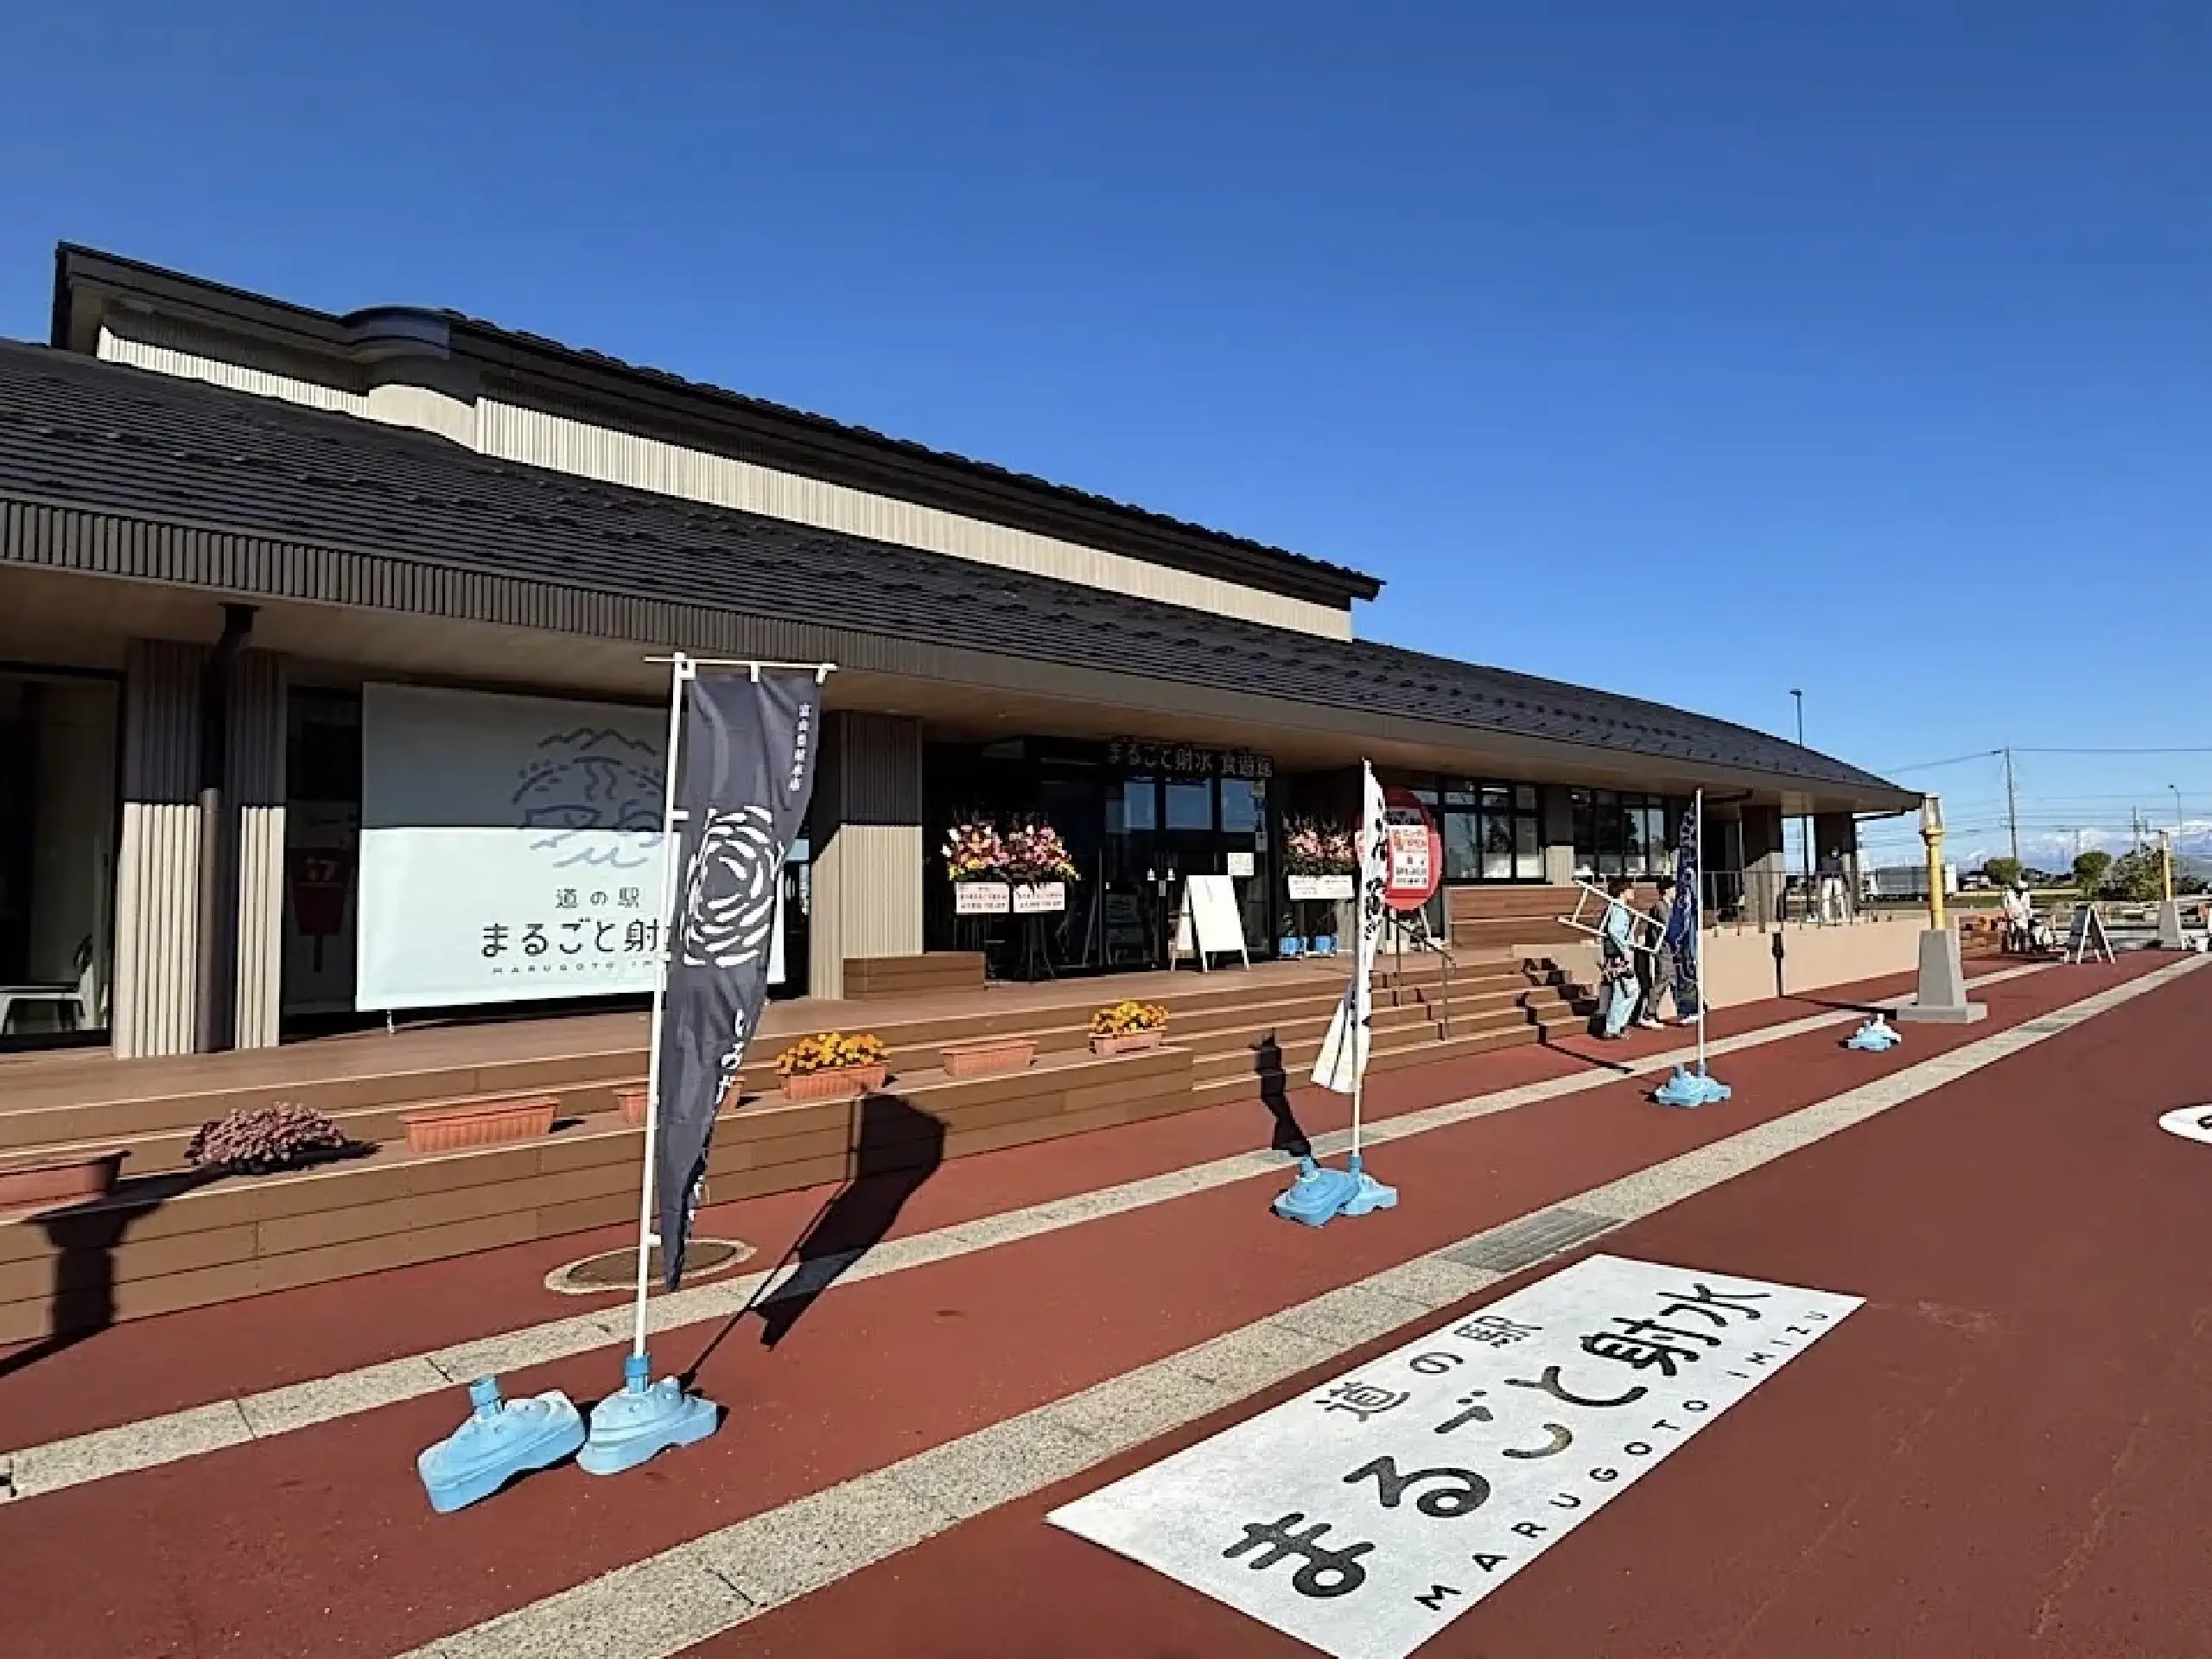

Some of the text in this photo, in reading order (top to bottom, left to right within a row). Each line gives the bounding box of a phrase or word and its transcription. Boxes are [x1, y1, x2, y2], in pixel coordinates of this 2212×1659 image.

[480, 917, 671, 958] まるごと射
[555, 886, 640, 909] 道の駅
[1313, 1315, 1544, 1423] 道の駅
[1223, 1282, 1772, 1599] まるごと射水
[1414, 1310, 1831, 1612] MARUGOTO IMIZU
